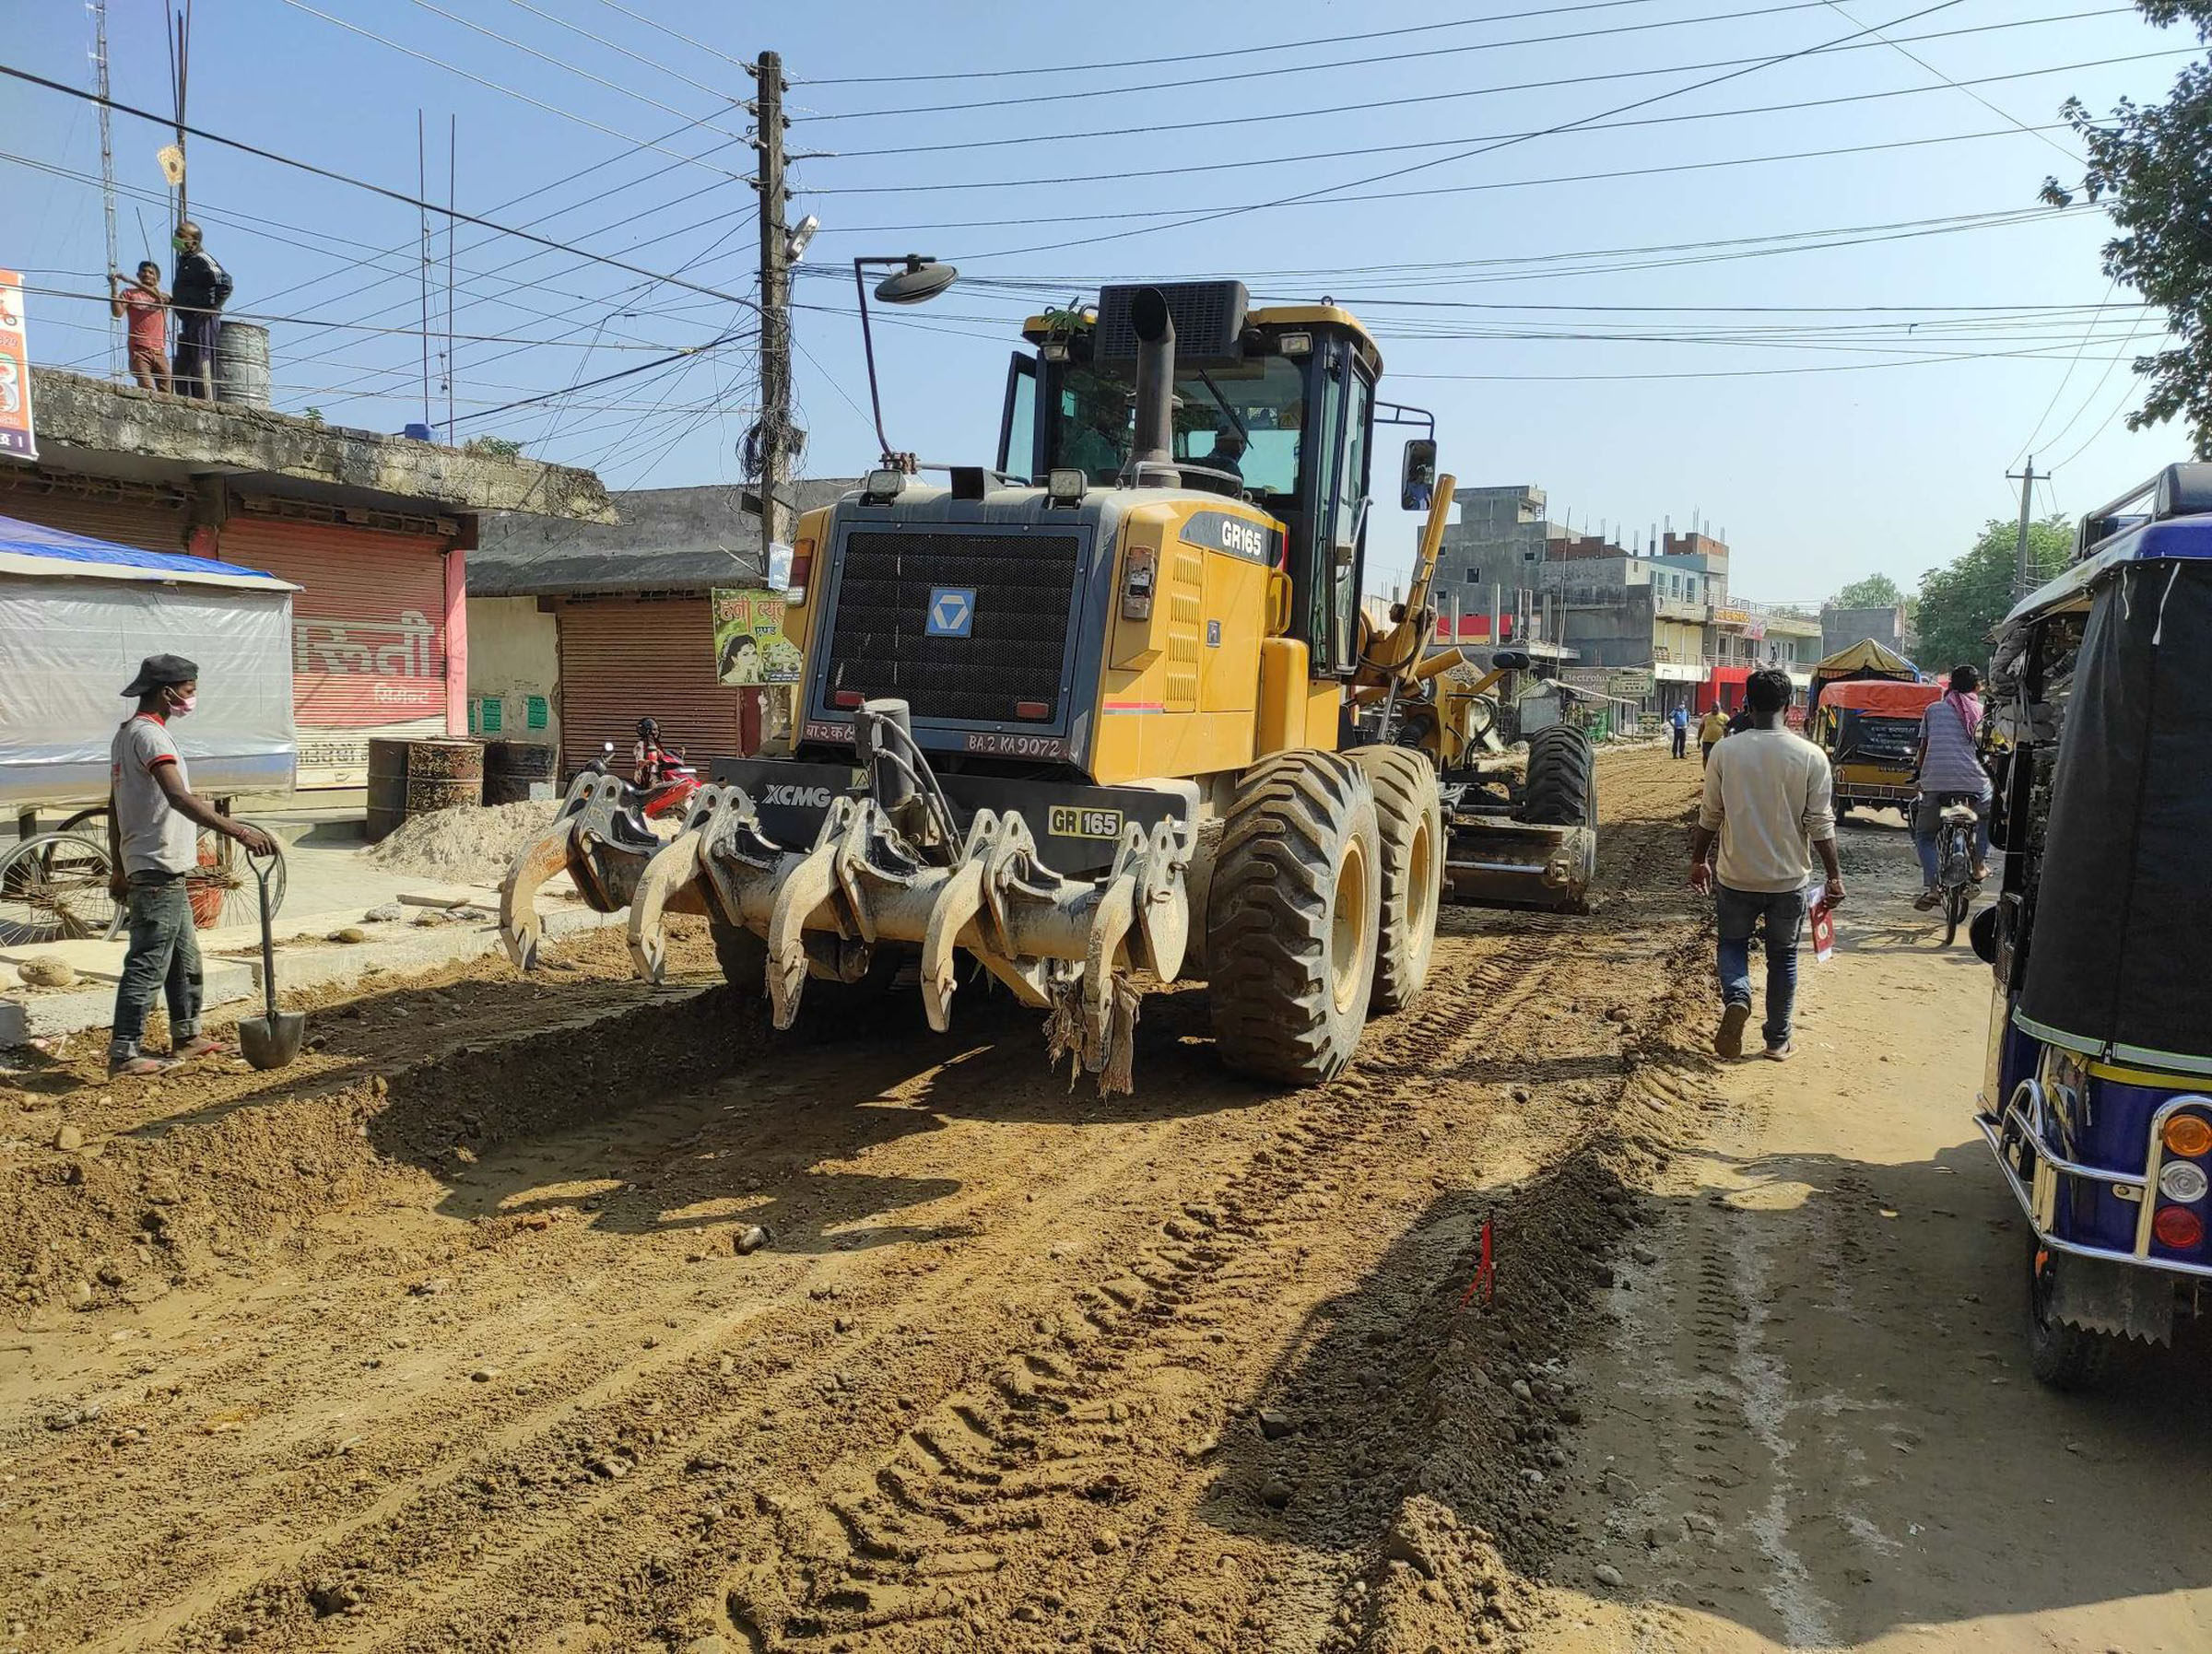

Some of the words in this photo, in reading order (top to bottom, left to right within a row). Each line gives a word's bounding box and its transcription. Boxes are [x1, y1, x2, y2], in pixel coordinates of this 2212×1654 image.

[1221, 520, 1262, 557] GR165
[1562, 674, 1610, 682] Electrolux
[761, 784, 831, 808] XCMG
[1053, 809, 1077, 833] GR
[1084, 812, 1117, 836] 165
